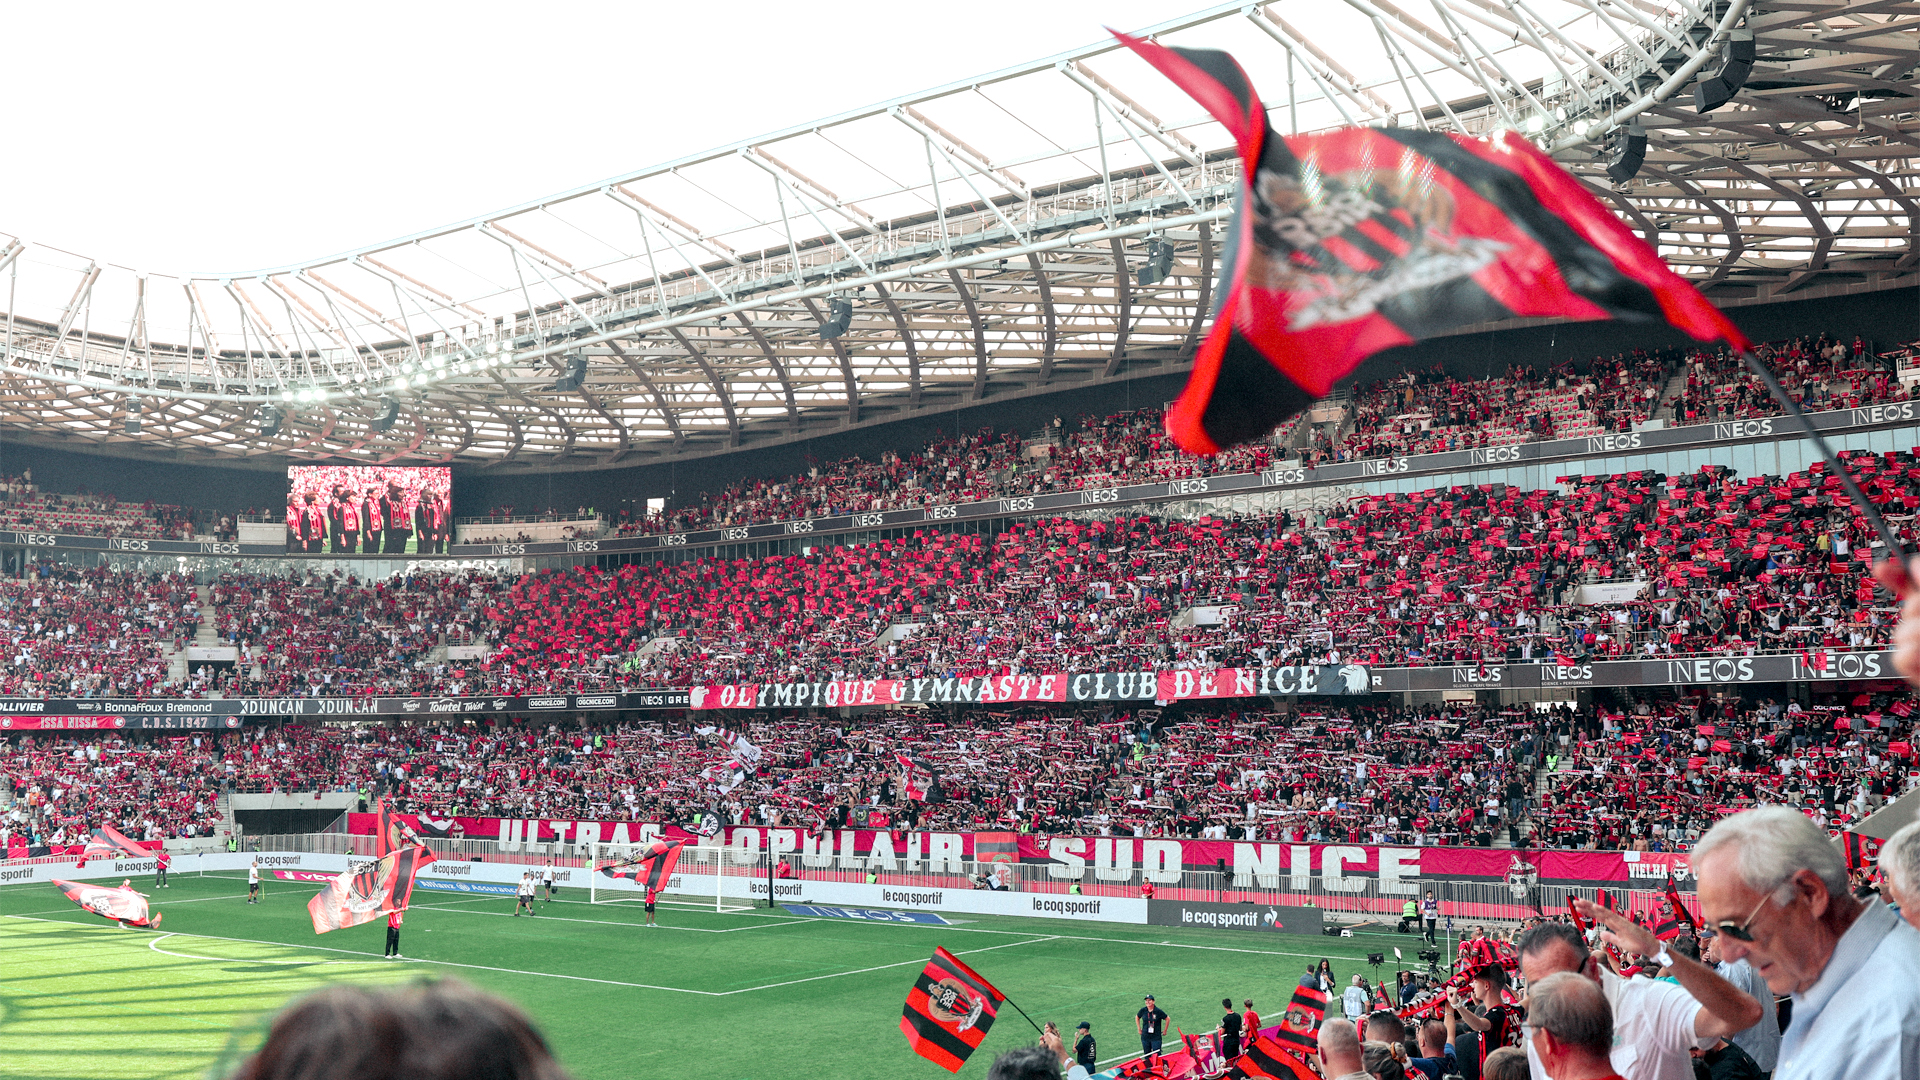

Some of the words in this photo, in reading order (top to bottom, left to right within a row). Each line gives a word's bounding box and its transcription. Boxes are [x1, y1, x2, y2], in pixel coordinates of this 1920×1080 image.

[1851, 404, 1914, 425] INEOS
[1714, 419, 1773, 440] INEOS
[1587, 433, 1642, 452] INEOS
[1470, 446, 1521, 464] INEOS
[1362, 458, 1409, 477] INEOS
[1261, 469, 1305, 487] INEOS
[1169, 480, 1208, 495] INEOS
[1081, 488, 1118, 504] INEOS
[1000, 498, 1034, 513] INEOS
[852, 513, 882, 527] INEOS
[925, 506, 956, 520] INEOS
[785, 519, 813, 533] INEOS
[16, 532, 56, 546] INEOS
[659, 533, 686, 546] INEOS
[721, 527, 749, 541] INEOS
[109, 537, 148, 551] INEOS
[201, 543, 240, 554] INEOS
[491, 544, 525, 555] INEOS
[567, 540, 598, 552] INEOS
[1453, 667, 1501, 682] INEOS
[1541, 665, 1593, 680] INEOS
[1667, 658, 1754, 683] INEOS
[720, 680, 876, 707] OLYMPIQUE
[891, 674, 1056, 702] GYMNASTE
[1072, 672, 1158, 700] CLUB
[1174, 669, 1218, 698] DE
[1234, 665, 1320, 696] NICE
[105, 703, 163, 712] Bonnaffoux
[166, 702, 212, 712] Brémond
[429, 700, 461, 712] Tourtel
[463, 701, 486, 711] Twist
[641, 696, 663, 706] INEOS
[668, 696, 689, 704] GRE
[40, 717, 64, 728] ISSA
[67, 717, 98, 728] NISSA
[142, 717, 176, 728] C.D.S.
[179, 717, 208, 728] 1947
[500, 818, 661, 855] ULTRAS
[698, 828, 980, 875] POPULAIR
[115, 862, 124, 872] le
[125, 863, 141, 873] coq
[142, 862, 158, 872] spo
[264, 856, 281, 866] coq
[282, 855, 301, 865] sportif
[1048, 837, 1183, 884] SUD
[1233, 843, 1421, 896] NICE
[1, 868, 34, 881] sportif
[432, 863, 438, 873] le
[438, 865, 450, 876] coq
[450, 864, 471, 877] sportif
[1628, 863, 1668, 879] VIELHA
[420, 880, 456, 890] Allianz
[758, 884, 768, 894] co
[774, 883, 802, 897] sportif
[883, 889, 891, 901] le
[893, 892, 909, 905] coq
[911, 891, 943, 907] sportif
[806, 906, 916, 922] INEOS
[1032, 898, 1042, 910] le
[1044, 902, 1063, 915] coq
[1065, 900, 1101, 916] sportif
[1182, 908, 1192, 923] le
[1194, 913, 1216, 927] coq
[1218, 911, 1258, 928] sportif
